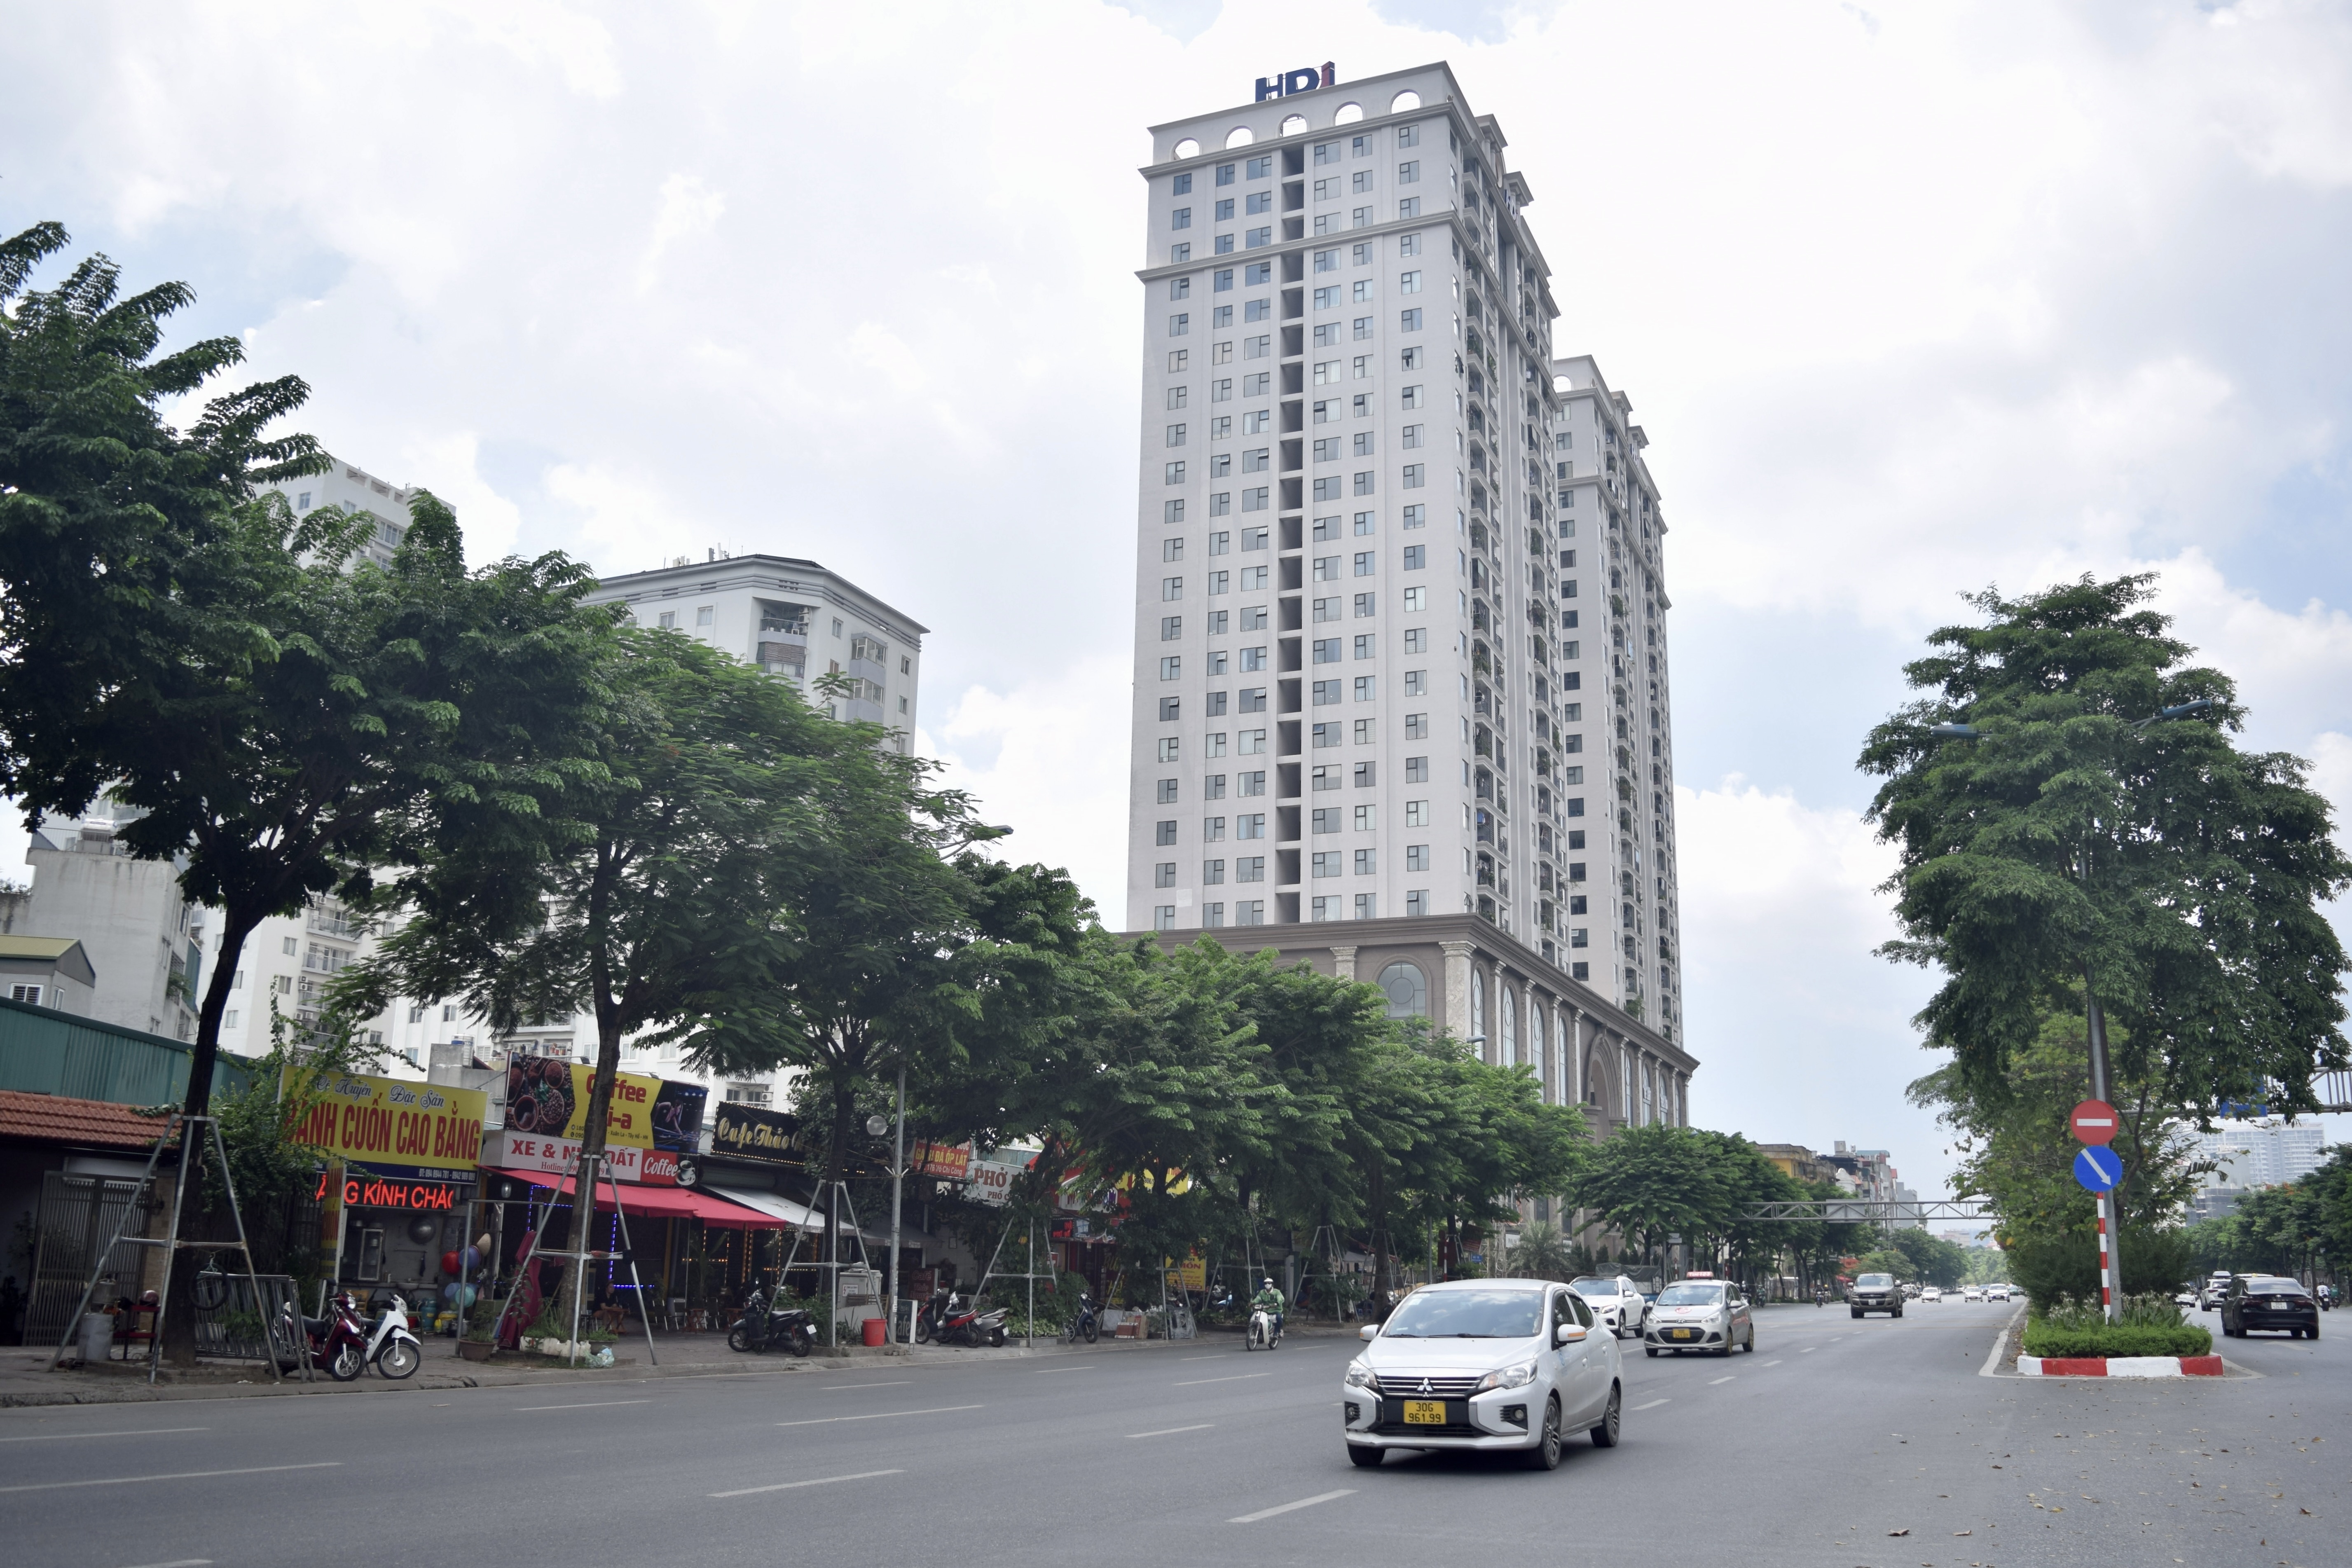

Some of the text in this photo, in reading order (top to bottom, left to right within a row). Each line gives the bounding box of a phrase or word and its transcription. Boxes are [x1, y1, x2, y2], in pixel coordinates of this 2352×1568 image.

[389, 1085, 416, 1105] Đặc
[420, 1089, 445, 1109] Sản
[586, 1073, 646, 1103] Cffee
[342, 1093, 393, 1152] CUỐN
[396, 1111, 431, 1156] CAO
[433, 1101, 481, 1161] BẰNG
[606, 1106, 632, 1130] i-a
[718, 1117, 753, 1149] Cafe
[511, 1139, 536, 1156] XE
[542, 1143, 556, 1158] &
[935, 1149, 944, 1163] ĐÁ
[541, 1161, 566, 1172] Hotline:
[644, 1156, 679, 1177] Coffee
[927, 1163, 935, 1172] 176
[950, 1167, 962, 1177] Công
[973, 1167, 1008, 1188] PHỞ
[363, 1179, 407, 1207] KÍNH
[987, 1189, 1003, 1200] PHỐ
[897, 1315, 910, 1336] afe
[1416, 1402, 1433, 1412] 30G
[1409, 1413, 1441, 1423] 961.99
